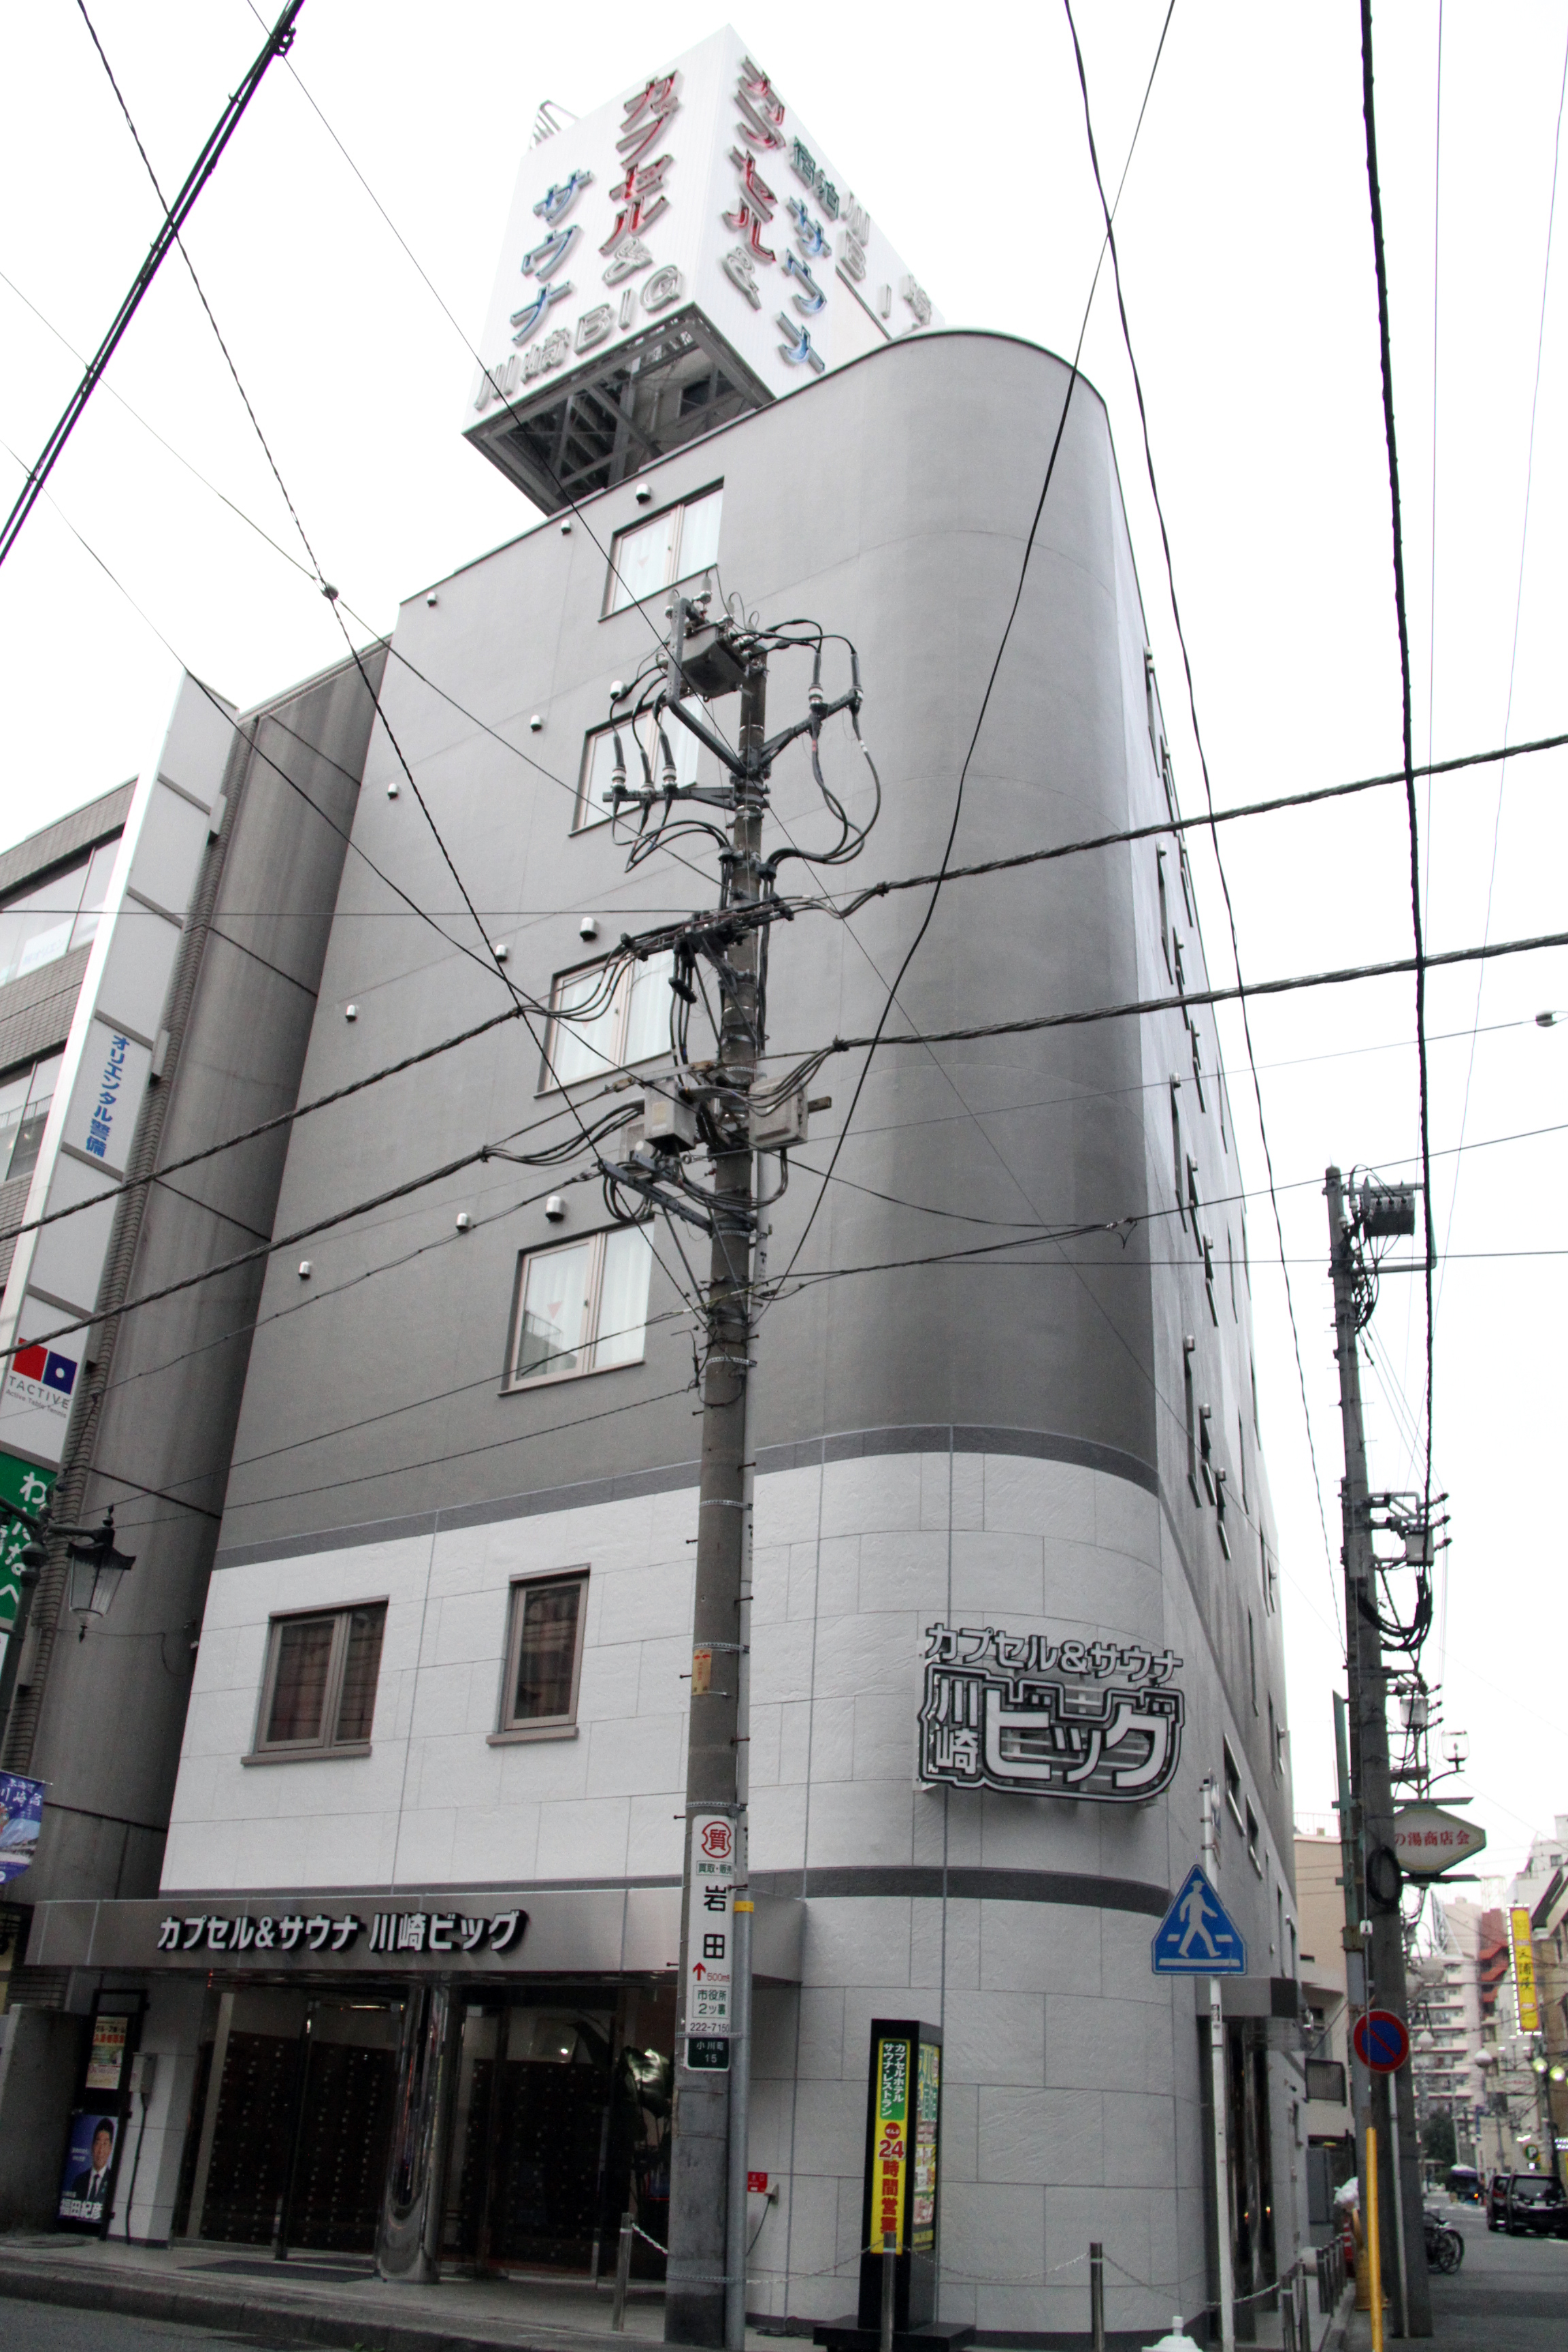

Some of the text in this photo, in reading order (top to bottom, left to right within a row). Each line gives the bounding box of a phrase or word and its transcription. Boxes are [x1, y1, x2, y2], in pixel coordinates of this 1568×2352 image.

[510, 169, 593, 346] サウナ
[777, 195, 832, 374] サウナ
[86, 1035, 129, 1158] オリエンタル警備
[9, 1375, 70, 1409] TACTIVE
[925, 1623, 1183, 1684] カプセル&サウナ
[935, 1678, 979, 1774] 川崎
[983, 1688, 1173, 1789] ビッグ
[709, 1829, 726, 1851] 質
[157, 1910, 521, 1952] カプセル&サウナ 川崎ビッグ
[704, 1885, 727, 1959] 岩田
[698, 1990, 727, 2001] 市役所
[698, 2003, 726, 2015] 2ツ裏
[690, 2022, 730, 2032] 222-7150
[696, 2042, 724, 2051] 小川町
[705, 2055, 717, 2063] 15
[893, 2044, 906, 2103] カプセルホテル
